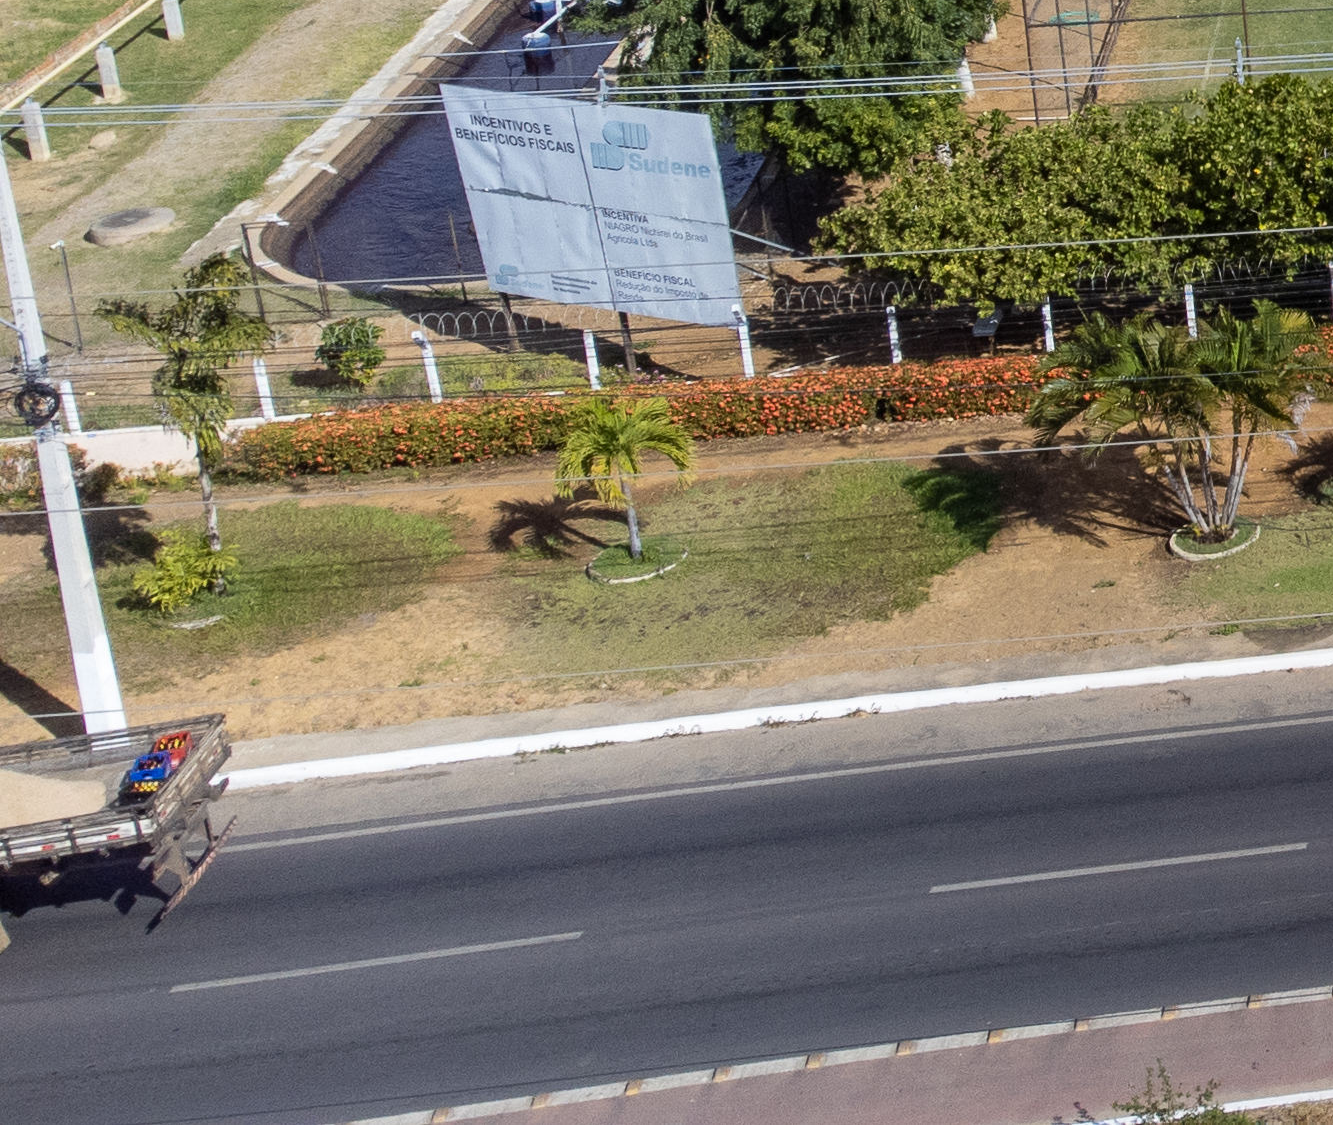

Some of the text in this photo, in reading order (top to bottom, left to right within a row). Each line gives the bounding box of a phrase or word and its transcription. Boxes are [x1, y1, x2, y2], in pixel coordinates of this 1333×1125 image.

[470, 114, 553, 136] INCENTIVOS E
[455, 128, 575, 154] BENEFÍCIOS FISCAIS
[628, 152, 711, 179] Sudene
[604, 221, 639, 234] NIAGRO
[685, 231, 708, 243] Brasil
[663, 275, 696, 288] FISCAL
